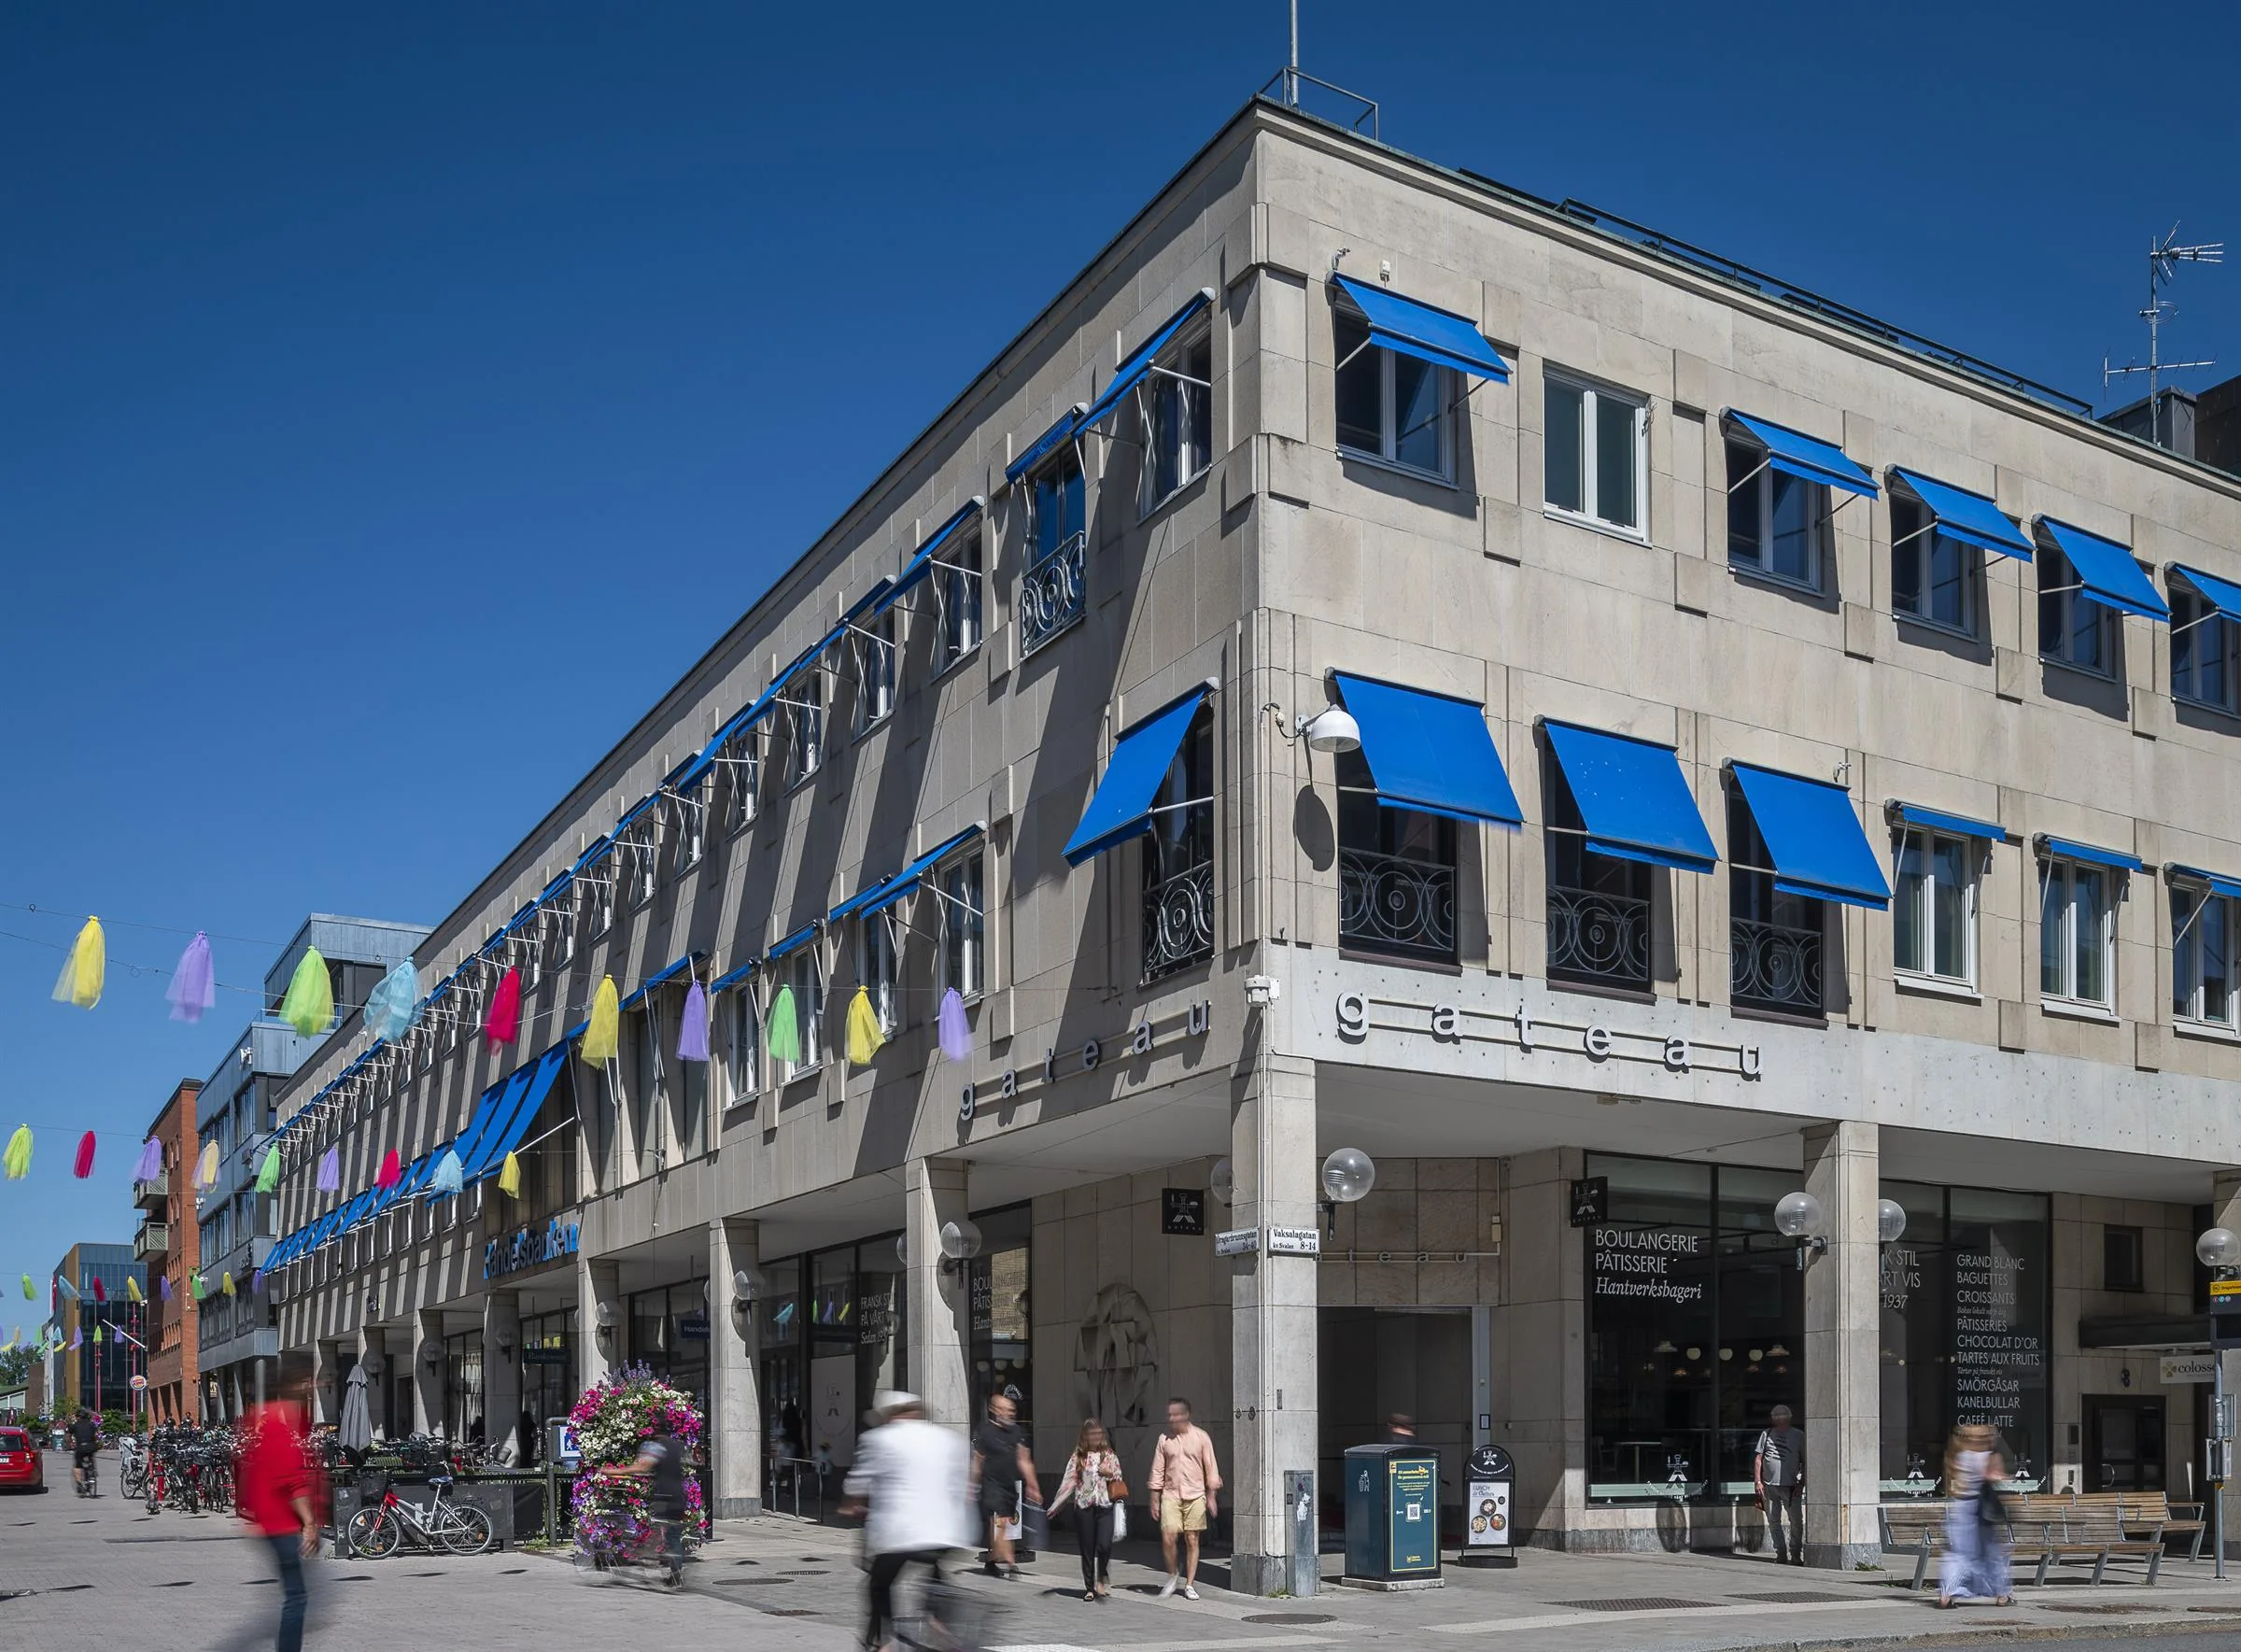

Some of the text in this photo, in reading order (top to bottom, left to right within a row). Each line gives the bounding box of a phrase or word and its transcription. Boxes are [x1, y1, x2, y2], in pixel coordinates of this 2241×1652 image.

[1336, 991, 1764, 1080] gateau
[960, 999, 1211, 1121] gateau
[1274, 1229, 1317, 1241] Vaksalagatan
[1595, 1229, 1698, 1253] BOULANGERIE
[484, 1219, 578, 1280] Handelsbanken
[1300, 1242, 1316, 1250] 8-14
[1595, 1250, 1668, 1274] PÂTISSERIE
[1896, 1250, 1920, 1266] STIL
[1957, 1254, 2025, 1270] GRAND BLANC
[1901, 1271, 1921, 1288] VIS
[1957, 1271, 2008, 1286] BAGUETTES
[1595, 1277, 1701, 1303] Hantverksbageri
[1883, 1294, 1909, 1309] 1937
[1957, 1291, 2015, 1306] CROISSANTS
[1957, 1316, 2008, 1332] PÂTISSERIES
[1957, 1334, 2038, 1349] CHOCOLAT D'OR
[1957, 1351, 2040, 1366] TARTES AUX FRUITS
[1957, 1377, 2020, 1392] SMÖRGÅSAR
[1957, 1397, 2021, 1409] KANELBULLAR
[1987, 1415, 2014, 1427] LATTE
